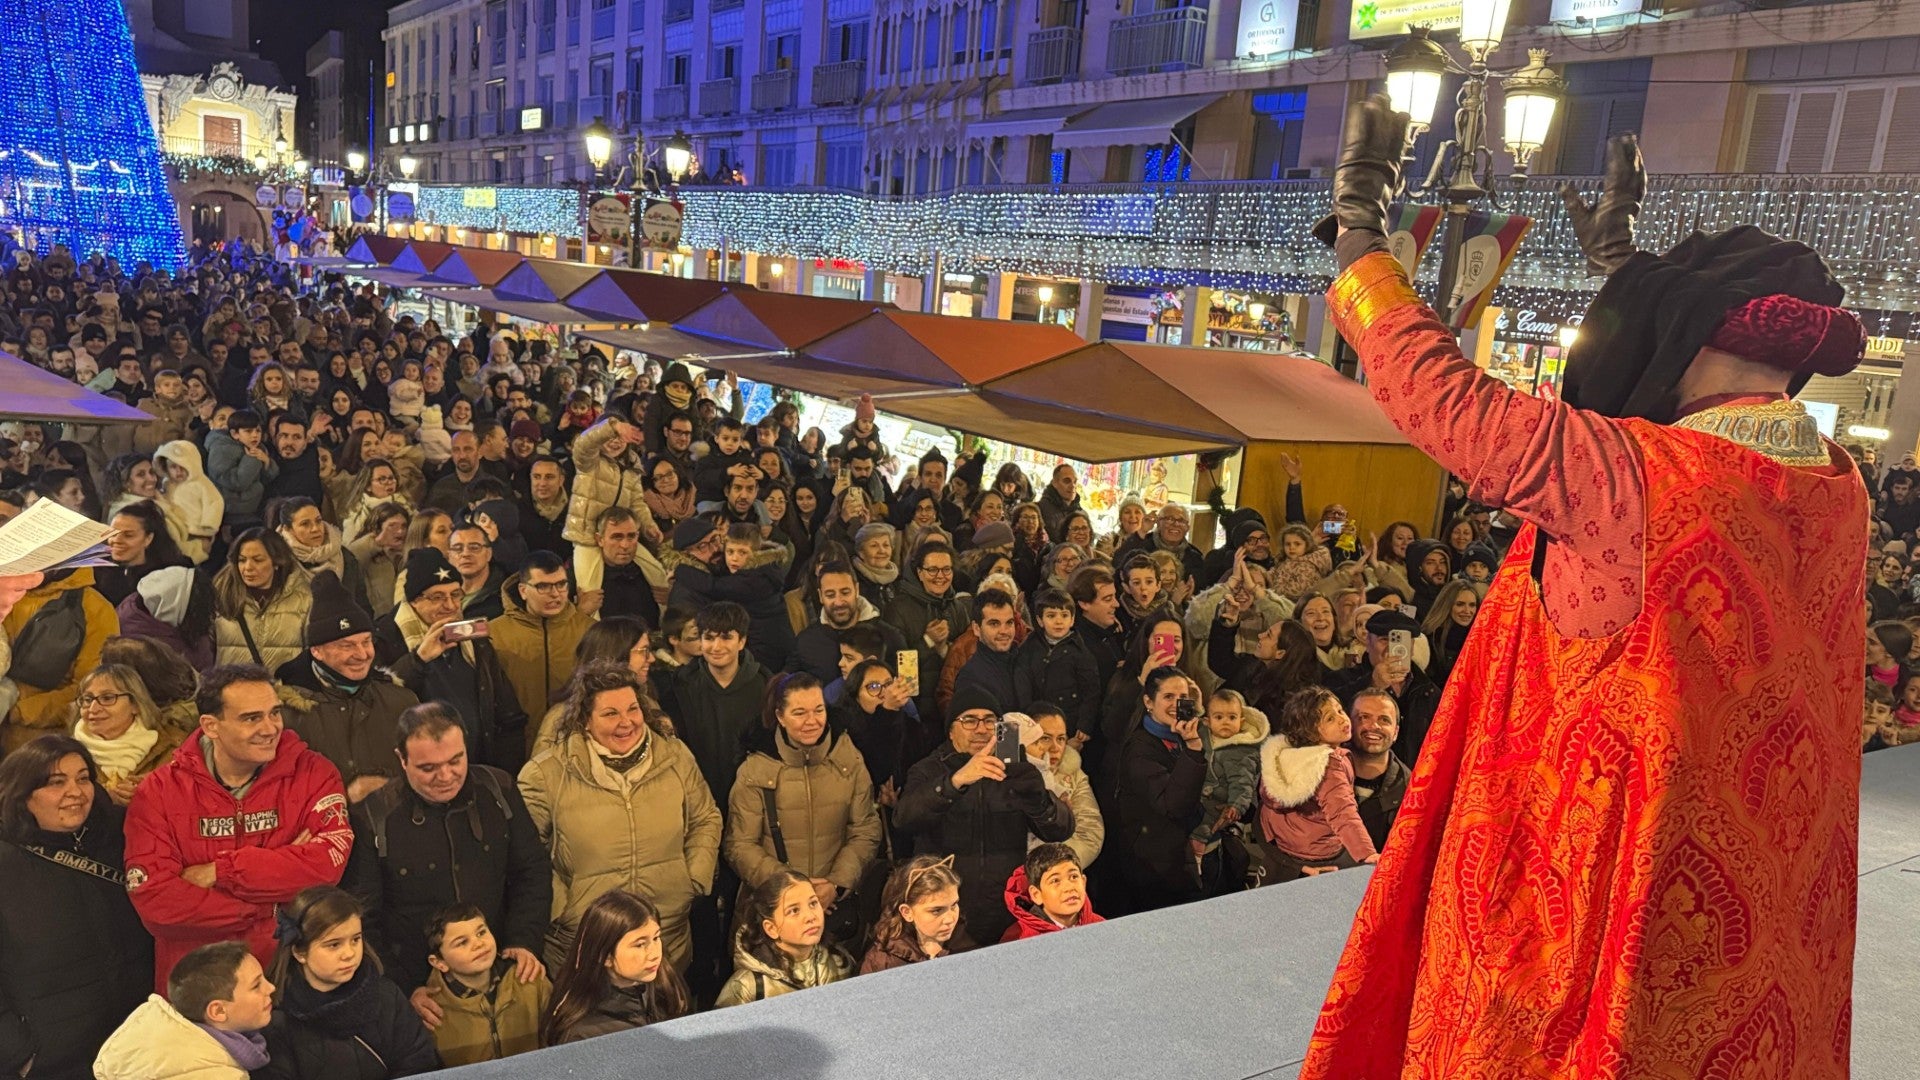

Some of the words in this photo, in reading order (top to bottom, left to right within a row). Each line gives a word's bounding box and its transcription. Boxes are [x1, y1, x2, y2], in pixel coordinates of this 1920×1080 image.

[1516, 309, 1558, 334] Como
[1510, 332, 1560, 342] COMPLEME
[53, 850, 98, 875] BIMBA
